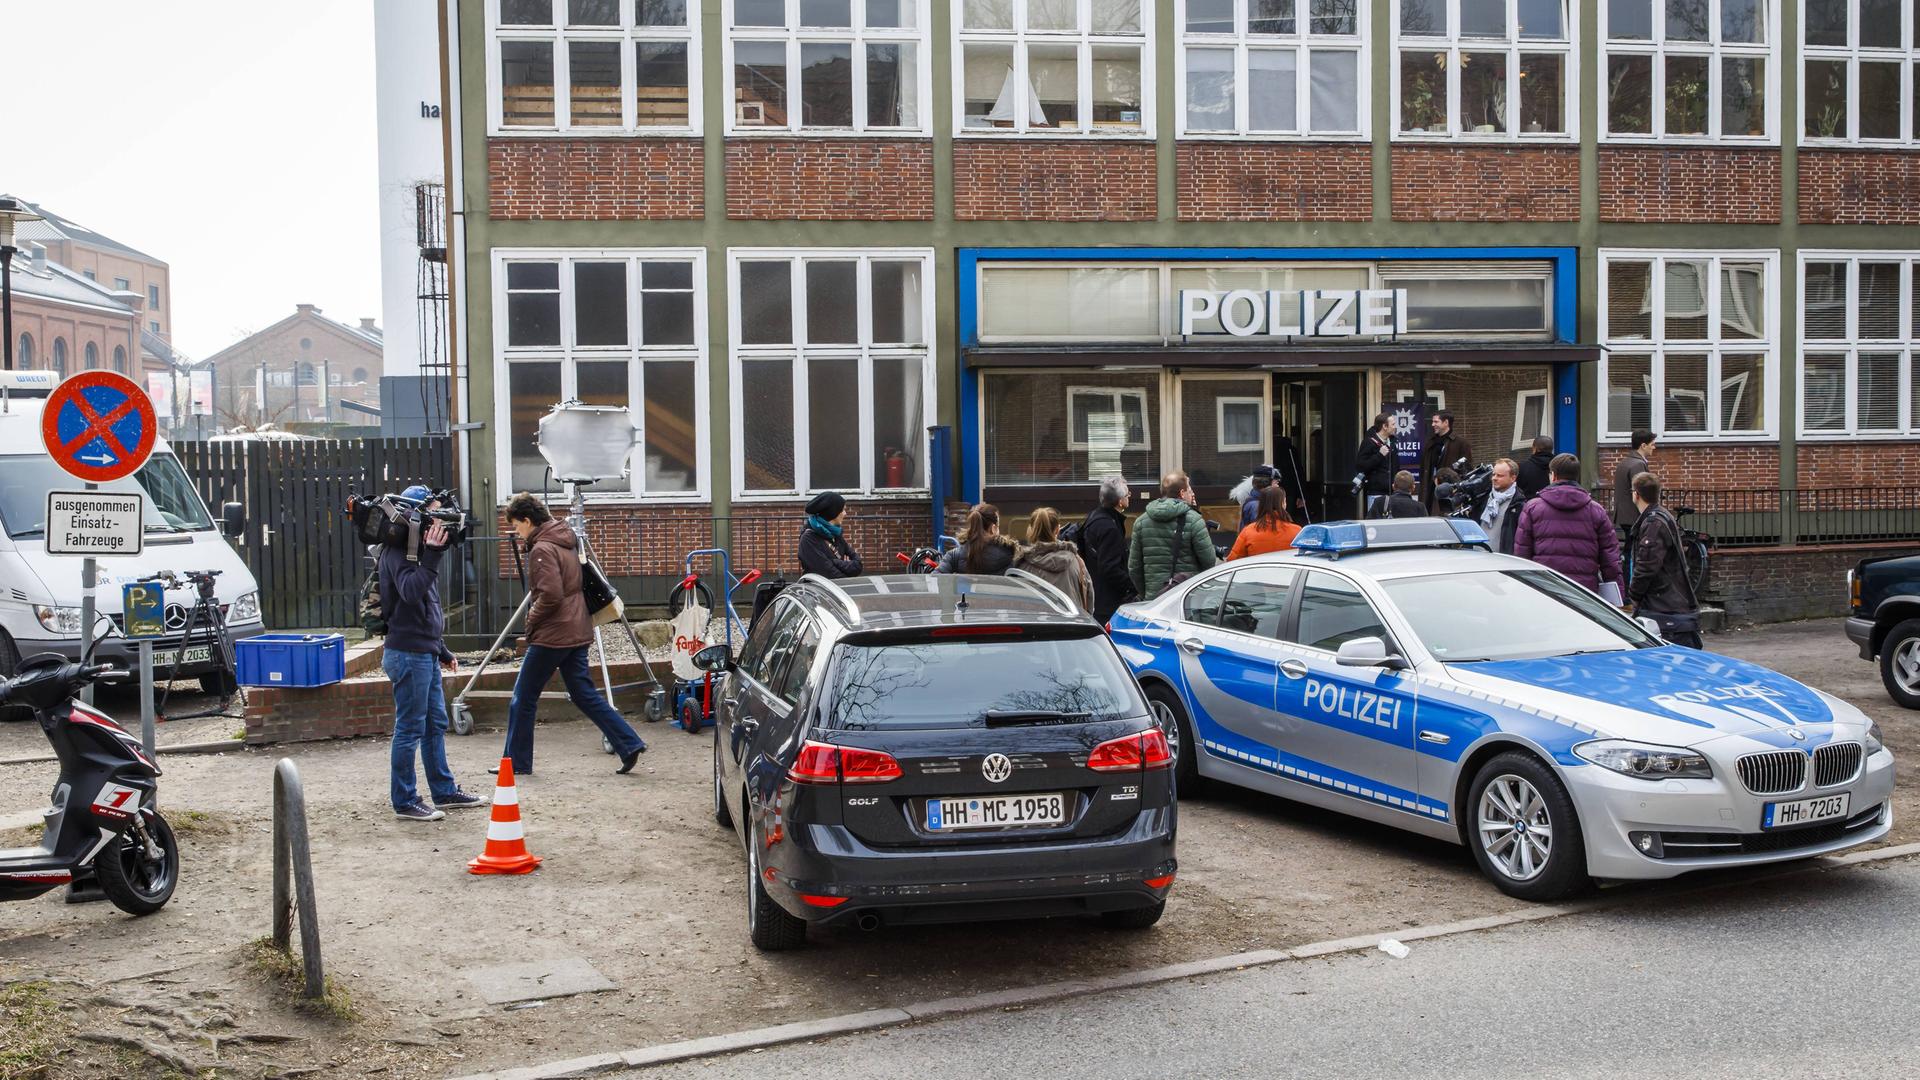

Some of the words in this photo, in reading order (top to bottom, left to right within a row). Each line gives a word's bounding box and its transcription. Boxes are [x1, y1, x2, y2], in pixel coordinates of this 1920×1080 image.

[1179, 288, 1408, 336] POLIZEI
[1564, 396, 1572, 406] 13
[1395, 441, 1421, 450] LIZEI
[55, 501, 136, 515] ausgenommen
[71, 514, 120, 529] Einsatz-
[65, 532, 124, 549] Fahrzeuge
[130, 587, 147, 609] P
[153, 652, 166, 664] HH
[187, 648, 211, 661] 2033
[1648, 683, 1787, 702] POLIZEI
[1303, 678, 1402, 730] POLIZEI
[848, 797, 879, 806] GOLF
[1781, 804, 1800, 823] HH
[1810, 797, 1842, 818] 7203
[942, 802, 968, 825] HH
[982, 800, 1008, 823] MC
[1013, 797, 1061, 821] 1958
